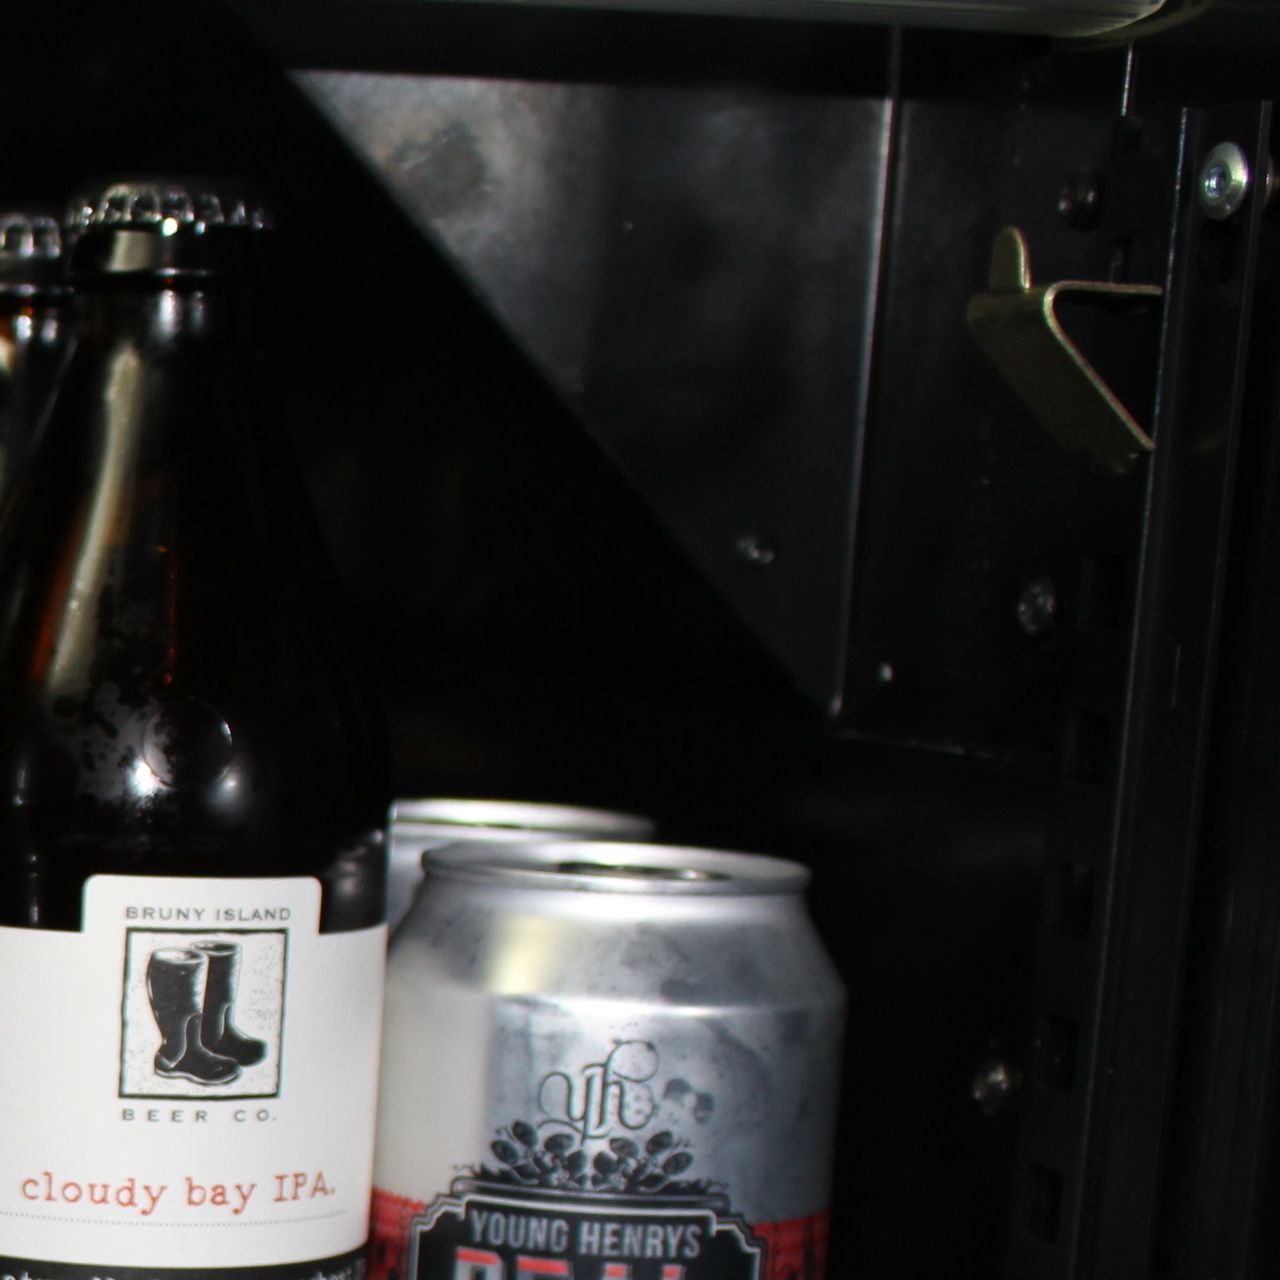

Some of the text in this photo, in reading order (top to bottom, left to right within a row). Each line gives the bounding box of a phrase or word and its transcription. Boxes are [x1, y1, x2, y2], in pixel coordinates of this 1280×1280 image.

[125, 906, 292, 921] BRUNY ISLAND
[122, 1108, 277, 1123] BEER CO.
[21, 1172, 336, 1216] cloudy bay IPA.
[469, 1209, 703, 1259] YOUNG HENRYS
